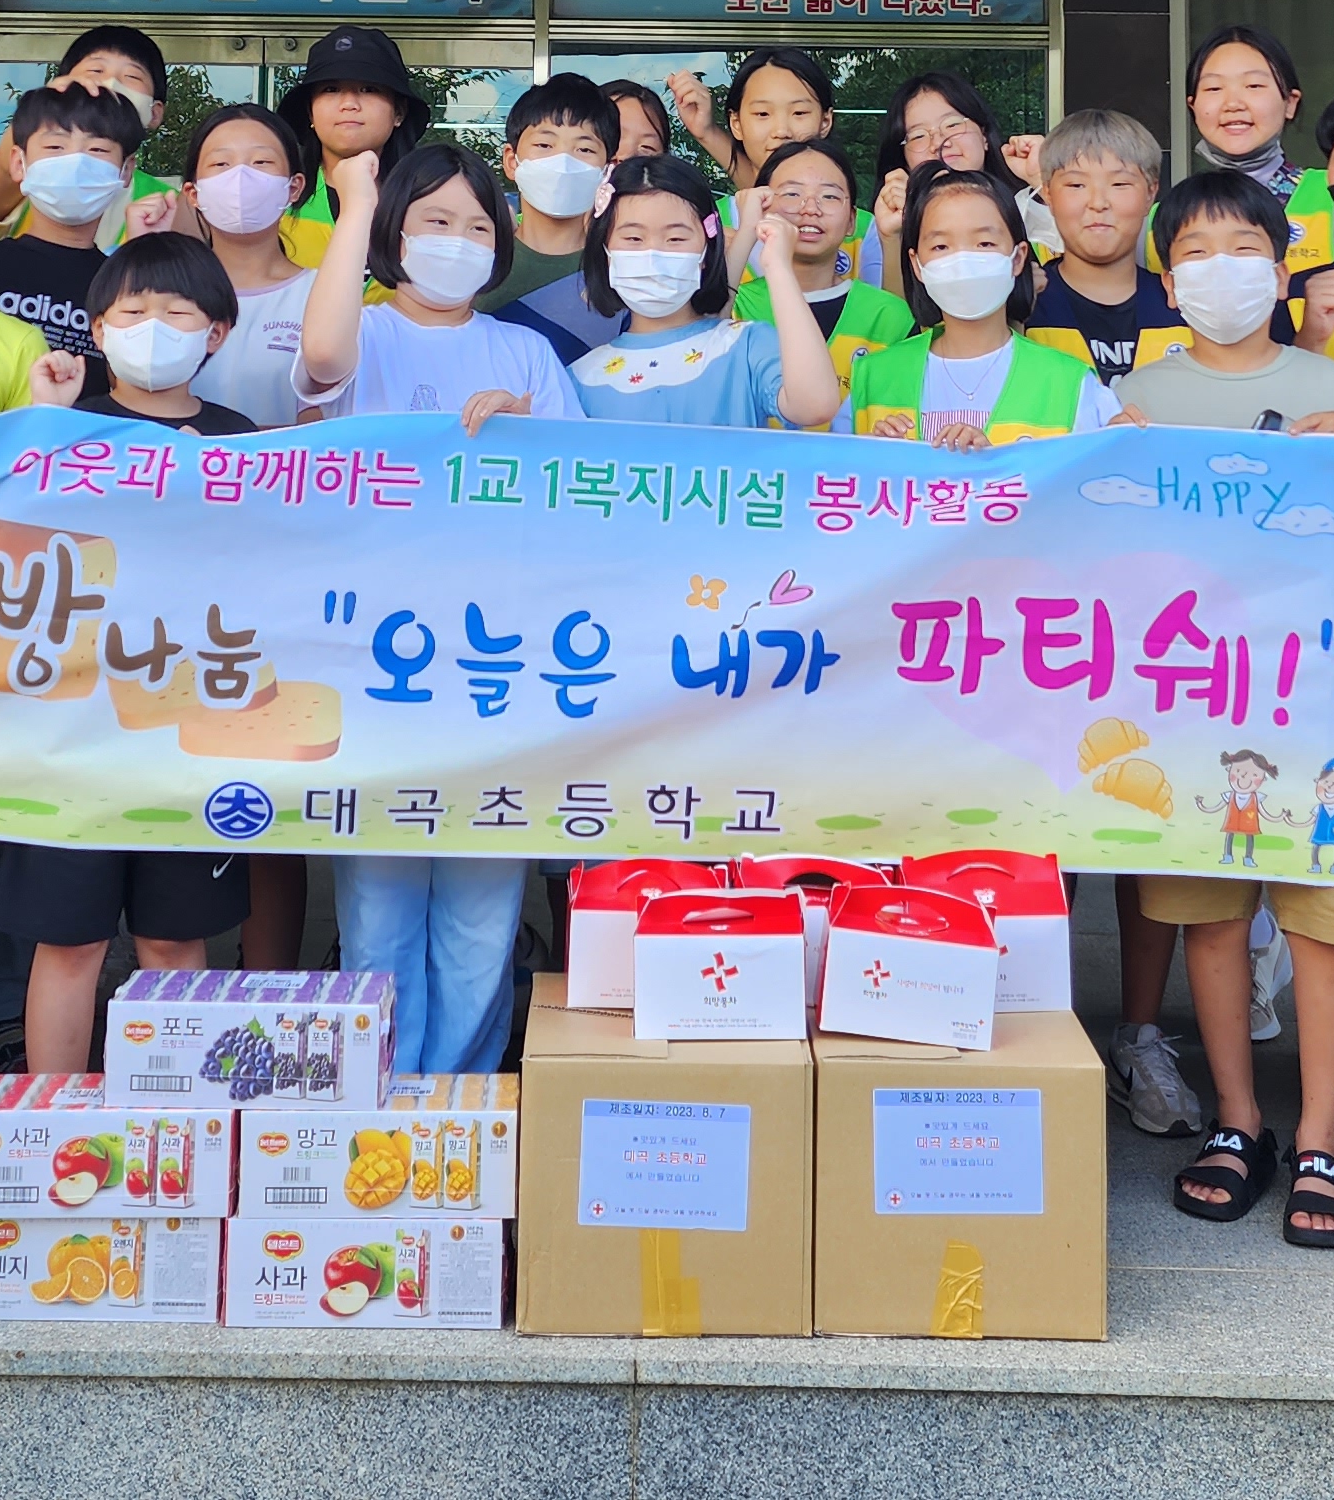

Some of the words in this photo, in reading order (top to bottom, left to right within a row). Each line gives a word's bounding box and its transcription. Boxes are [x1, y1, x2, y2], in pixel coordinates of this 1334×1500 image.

[12, 441, 176, 499] 이웃과
[200, 446, 422, 507] 함께하는
[445, 453, 525, 505] 1교
[542, 458, 786, 530] 1복지시설
[1156, 466, 1291, 529] HAPPY
[104, 603, 262, 701] 나눔
[671, 629, 841, 698] 내가
[305, 783, 781, 840] 대곡초등학교
[161, 1018, 204, 1036] 포도
[900, 1091, 950, 1103] 제조일자:
[955, 1092, 986, 1104] 2023.
[992, 1092, 1003, 1104] 8.
[609, 1103, 660, 1115] 제조일자:
[666, 1105, 696, 1117] 2023.
[702, 1108, 713, 1118] 8.
[9, 1127, 51, 1147] 사과
[297, 1128, 337, 1149] 망고
[917, 1136, 941, 1149] 대곡
[949, 1136, 1000, 1149] 초등학교
[623, 1150, 649, 1163] 대곡
[656, 1151, 707, 1165] 초등학교
[255, 1266, 308, 1291] 사과
[253, 1294, 284, 1306] 드링크
